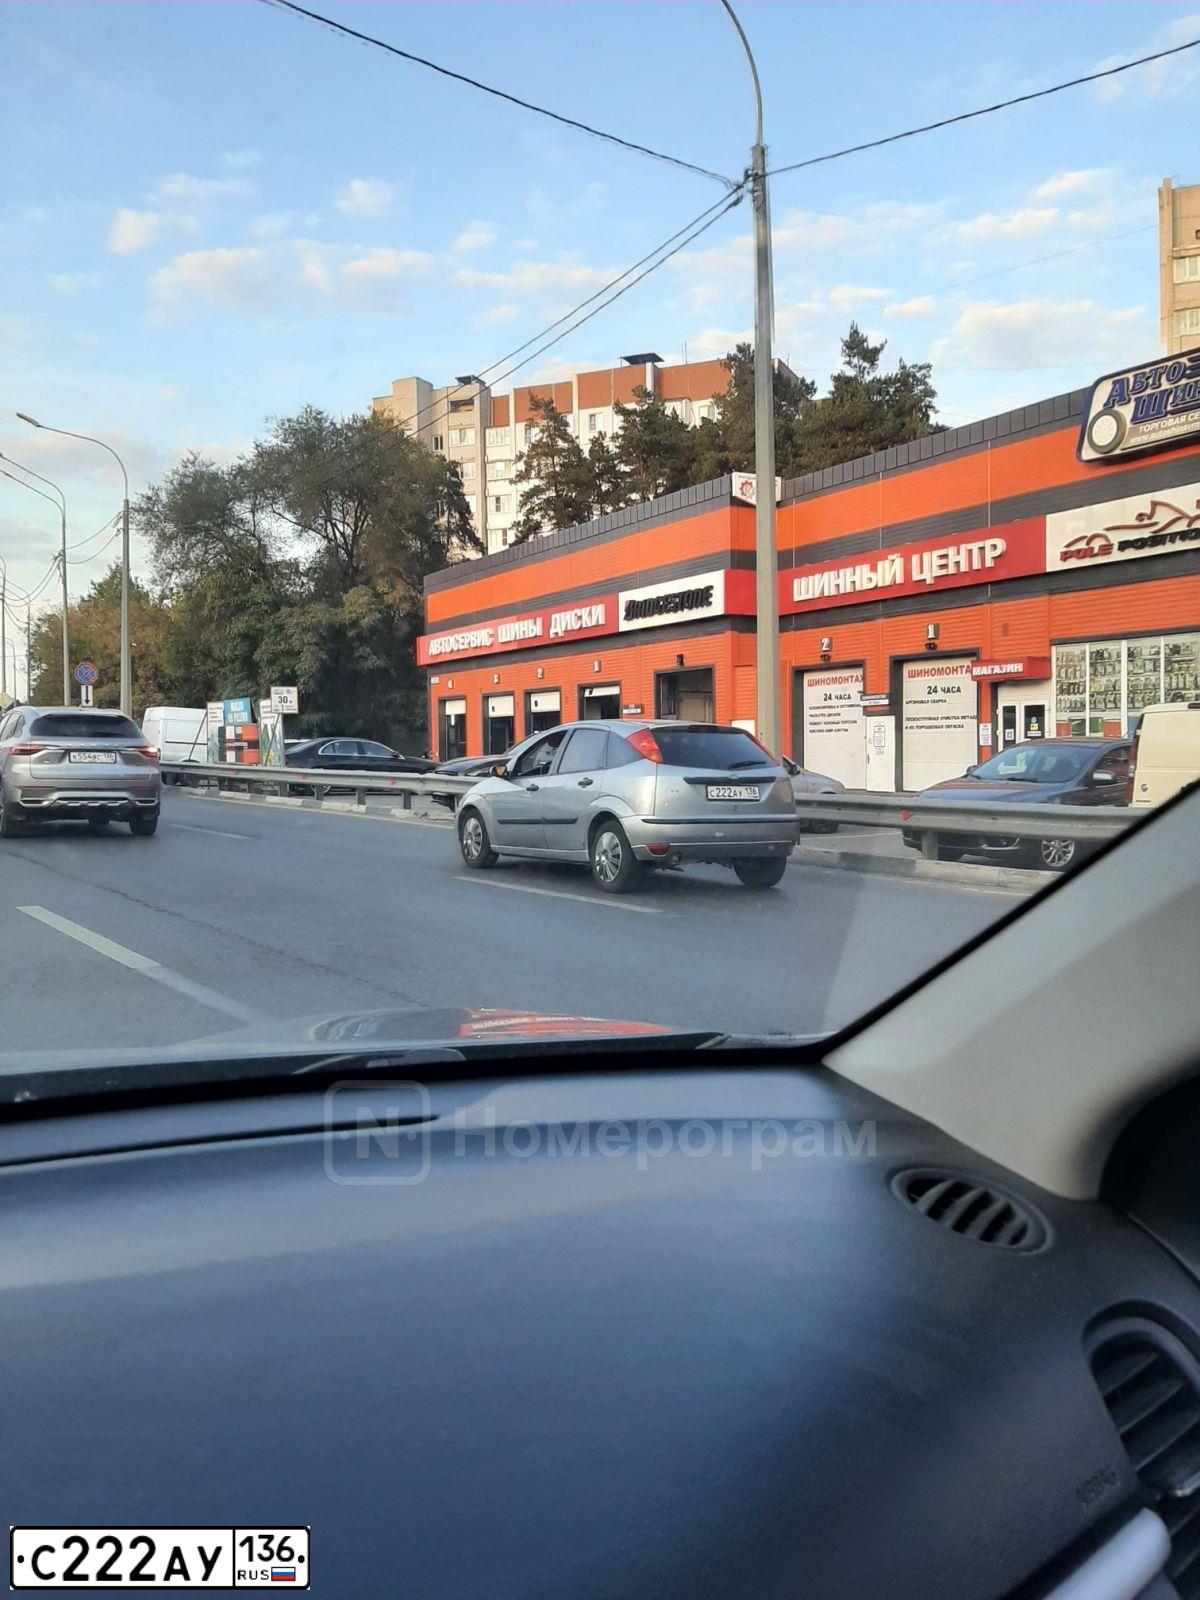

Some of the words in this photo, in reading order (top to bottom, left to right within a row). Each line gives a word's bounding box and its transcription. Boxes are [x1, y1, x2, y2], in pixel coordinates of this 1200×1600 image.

[1140, 414, 1186, 432] ТОРГОВАЯ
[1060, 543, 1114, 562] POLE
[793, 553, 905, 602] ШИННЫЙ
[911, 538, 1008, 585] ЦЕНТР
[428, 628, 495, 657] АВТОСЕРВИС
[497, 617, 543, 643] ШИНЫ
[550, 604, 606, 638] ДИСКИ
[926, 623, 937, 639] 1
[821, 637, 832, 651] 2
[972, 662, 1024, 676] МАГАЗИН
[823, 693, 832, 702] 24
[926, 685, 938, 695] 24
[940, 685, 962, 694] ЧАСА
